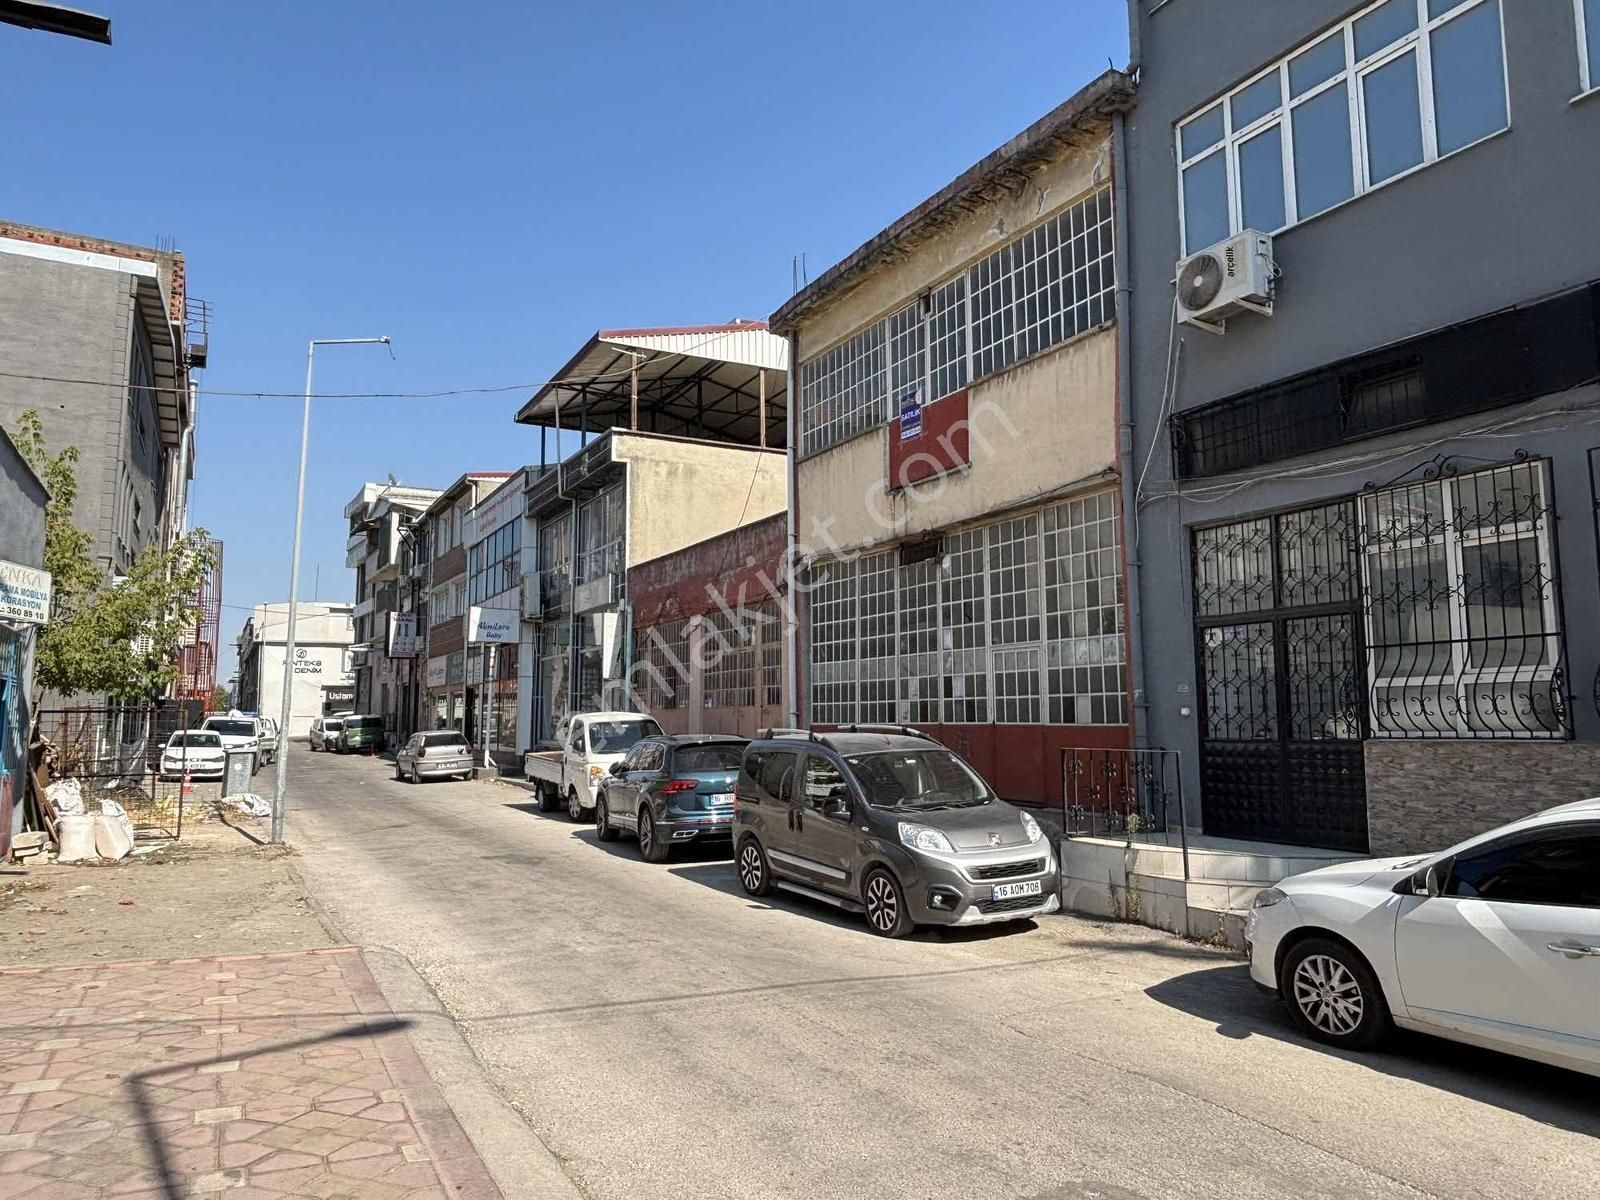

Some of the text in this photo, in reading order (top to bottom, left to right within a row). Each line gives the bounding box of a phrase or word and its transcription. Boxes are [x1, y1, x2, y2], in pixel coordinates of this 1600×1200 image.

[1225, 246, 1235, 277] arçelik
[20, 588, 48, 600] MOBİLYA
[7, 607, 22, 616] 360
[24, 610, 33, 618] 89
[1000, 886, 1007, 896] 16
[1025, 882, 1039, 893] 708
